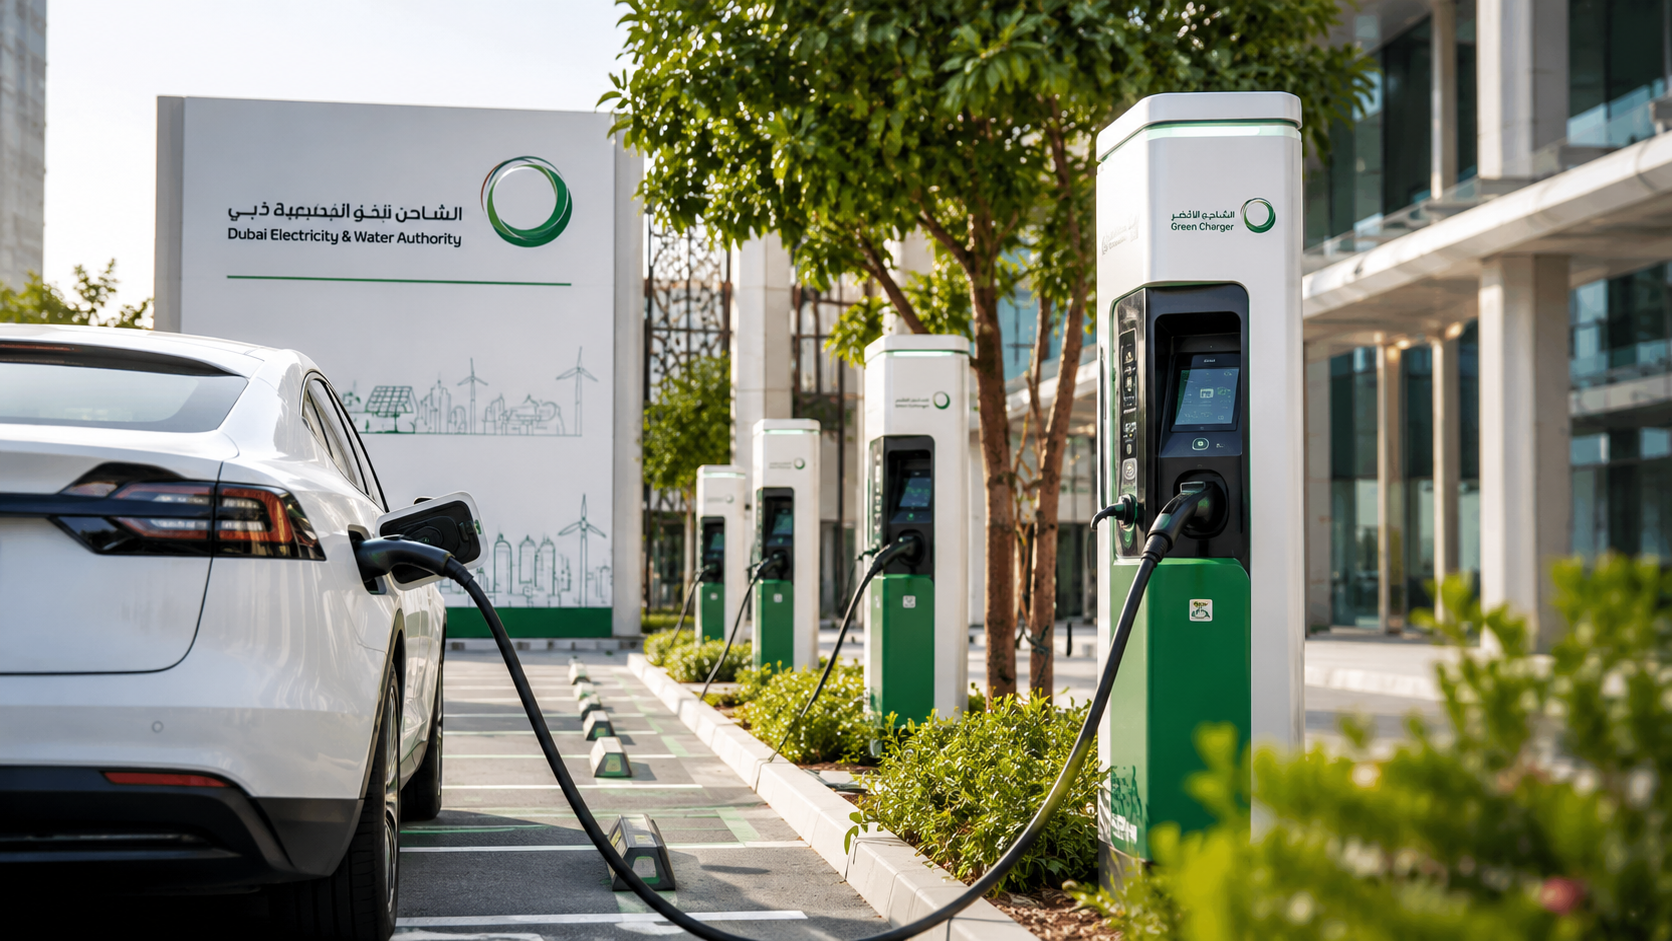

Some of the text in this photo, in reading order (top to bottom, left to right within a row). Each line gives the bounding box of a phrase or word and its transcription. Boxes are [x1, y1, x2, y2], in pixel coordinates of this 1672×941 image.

[1171, 222, 1234, 232] Green Charger
[228, 228, 462, 248] Dubai Electricity & Water Authority
